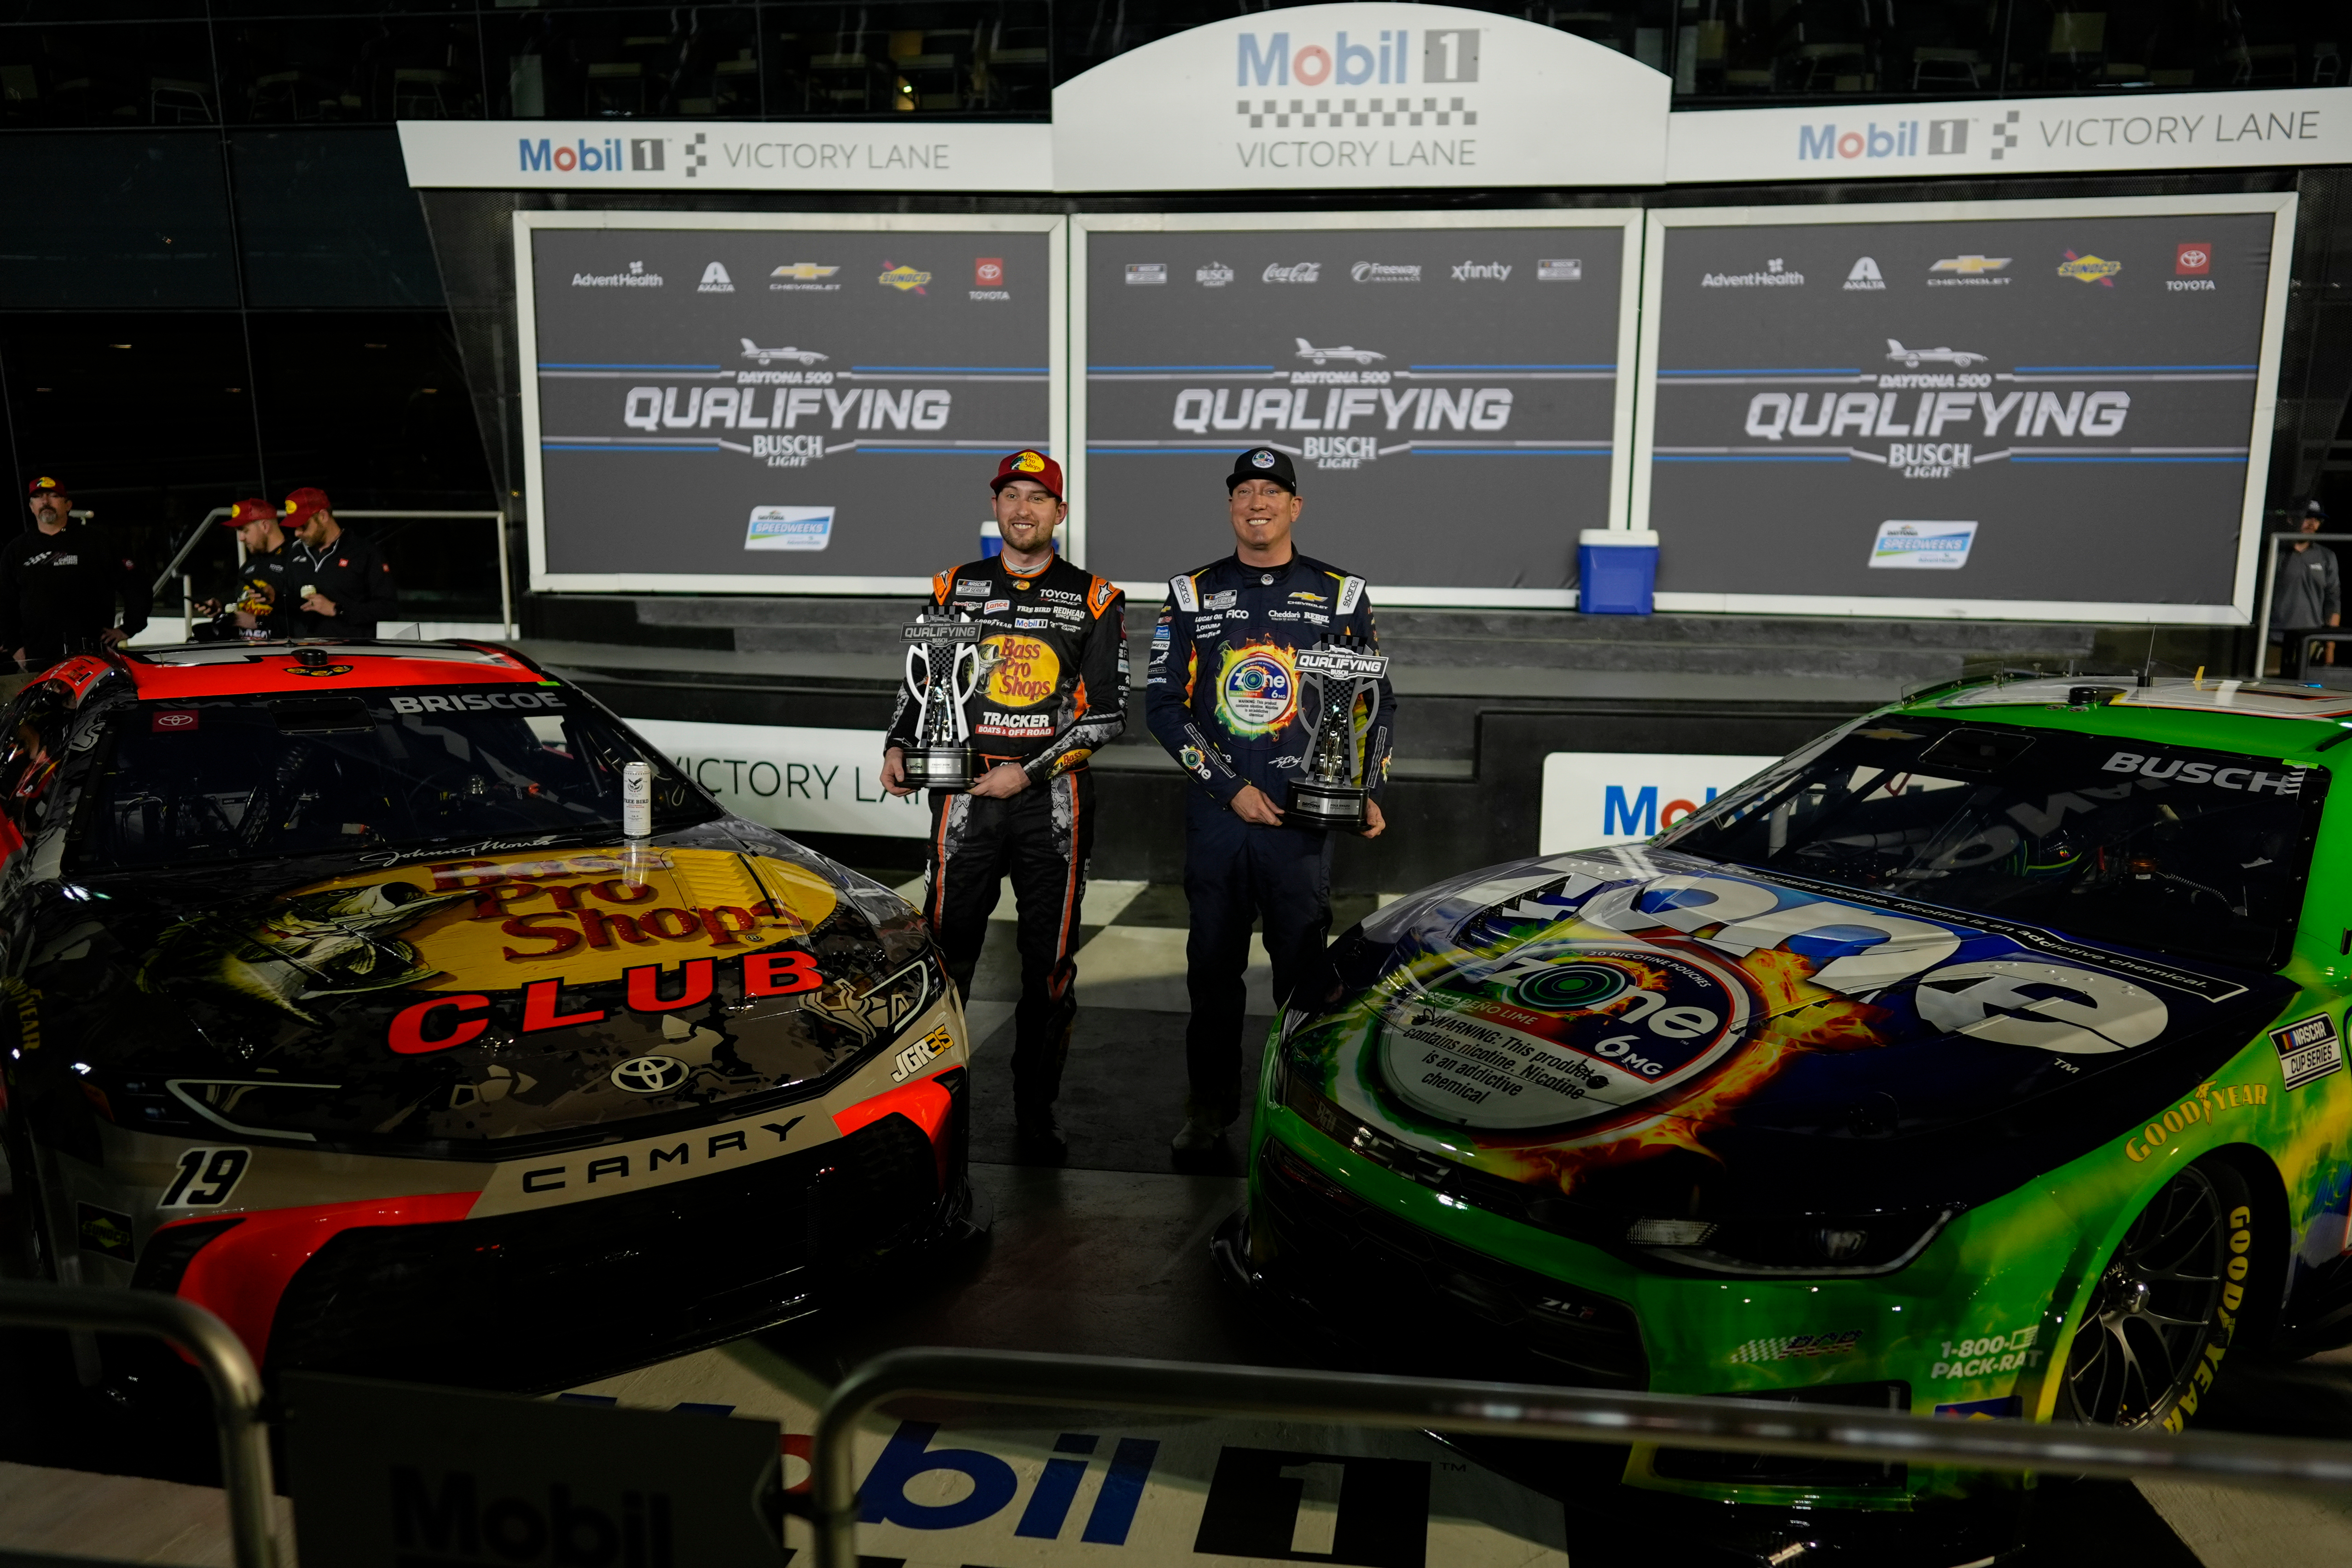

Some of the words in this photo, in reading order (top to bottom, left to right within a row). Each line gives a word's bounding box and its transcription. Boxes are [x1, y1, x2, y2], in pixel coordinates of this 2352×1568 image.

[1237, 30, 1408, 87] Mobil
[1798, 121, 1917, 160] Mobil
[2039, 115, 2204, 148] VICTORY
[2216, 111, 2320, 143] LANE
[519, 139, 622, 172] Mobil
[723, 144, 857, 169] VICTORY
[869, 145, 950, 169] LANE
[1236, 140, 1379, 168] VICTORY
[1389, 139, 1477, 166] LANE
[880, 272, 931, 285] SUNOCO
[1372, 263, 1422, 276] Freeway
[1451, 260, 1512, 281] xfinity
[1701, 271, 1804, 288] AdventHealth
[2058, 261, 2121, 276] SUNOCO
[572, 273, 662, 288] AdventHealth
[697, 284, 735, 293] AXALTA
[1843, 280, 1886, 290] AXALTA
[2166, 280, 2216, 291] TOYOTA
[969, 291, 1010, 301] TOYOTA
[737, 371, 803, 385] DAYTONA
[803, 371, 834, 385] 500
[1290, 371, 1359, 384] DAYTONA
[1360, 371, 1390, 384] 500
[1878, 374, 1955, 388] DAYTONA
[1956, 373, 1992, 387] 500
[624, 387, 951, 431] QUALIFYING
[1173, 388, 1514, 433] QUALIFYING
[1744, 391, 2131, 440] QUALIFYING
[752, 435, 825, 459] BUSCH
[1025, 452, 1039, 461] Bass
[1303, 437, 1378, 460] BUSCH
[1888, 443, 1971, 468] BUSCH
[767, 456, 808, 467] LIGHT
[1024, 463, 1042, 471] Shops
[1317, 458, 1361, 469] LIGHT
[1904, 465, 1952, 478] LIGHT
[756, 523, 823, 533] SPEEDWEEKS
[1883, 539, 1963, 550] SPEEDWEEKS
[1040, 589, 1083, 602] TOYOTA
[1178, 578, 1191, 603] sparco
[1343, 580, 1357, 607] sparco
[1052, 606, 1086, 619] REDHEAD
[1226, 609, 1249, 619] FICO
[1268, 609, 1301, 618] Cheddar's
[1287, 601, 1328, 610] CHEVROLET
[974, 619, 1013, 629] GOODYEAR
[1303, 611, 1330, 624] REBEL
[905, 627, 976, 638] QUALIFYING
[1000, 637, 1041, 660] Bass
[1000, 657, 1031, 678] Pro
[1299, 655, 1382, 672] QUALIFYING
[999, 675, 1051, 701] Shops
[1234, 670, 1286, 690] zone
[392, 691, 567, 714] BRISCOE
[1271, 689, 1279, 698] 6
[978, 726, 1001, 734] BOATS
[983, 712, 1049, 728] TRACKER
[1063, 750, 1083, 764] Bass
[1178, 744, 1212, 781] zone
[2100, 751, 2294, 795] BUSCH
[359, 844, 475, 867] Johnny
[474, 838, 583, 851] Morris
[466, 879, 651, 921] Pro
[501, 897, 805, 961] Shops
[1757, 873, 1821, 889] contains
[1822, 888, 1889, 905] nicotine.
[1894, 902, 1968, 922] Nicotine
[1968, 917, 1988, 926] is
[1989, 923, 2016, 932] an
[2016, 929, 2106, 961] addictive
[2108, 957, 2208, 989] chemical.
[1610, 950, 1671, 966] NICOTINE
[1667, 962, 1712, 989] POUCHES
[388, 950, 825, 1055] CLUB
[1482, 957, 1719, 1039] zone
[1498, 1008, 1539, 1026] LIME
[1430, 1015, 1504, 1047] WARNING:
[1502, 1036, 1533, 1058] This
[2292, 1021, 2327, 1048] NASCAR
[891, 1024, 955, 1083] JGR35
[1403, 1027, 1459, 1053] contains
[1460, 1040, 1515, 1071] nicotine.
[1519, 1063, 1585, 1100] Nicotine
[1594, 1035, 1639, 1059] 6
[1620, 1053, 1664, 1076] MG
[2290, 1056, 2307, 1074] CUP
[2306, 1044, 2333, 1068] SERIES
[1422, 1049, 1434, 1064] is
[1436, 1056, 1455, 1070] an
[1458, 1062, 1523, 1097] addictive
[2053, 1057, 2080, 1074] TM
[1421, 1071, 1491, 1104] chemical
[2125, 1079, 2269, 1163] GOODYEAR
[522, 1114, 806, 1193] CAMRY
[159, 1148, 251, 1209] 19
[83, 1221, 131, 1246] SUNOCO
[1537, 1296, 1597, 1320] ZL1
[2161, 1205, 2251, 1435] GOODYEAR
[1775, 1329, 1865, 1360] RCR
[1930, 1349, 2045, 1380] PACK-RAT
[1439, 1462, 1467, 1472] TM
[389, 1464, 674, 1568] Mobil
